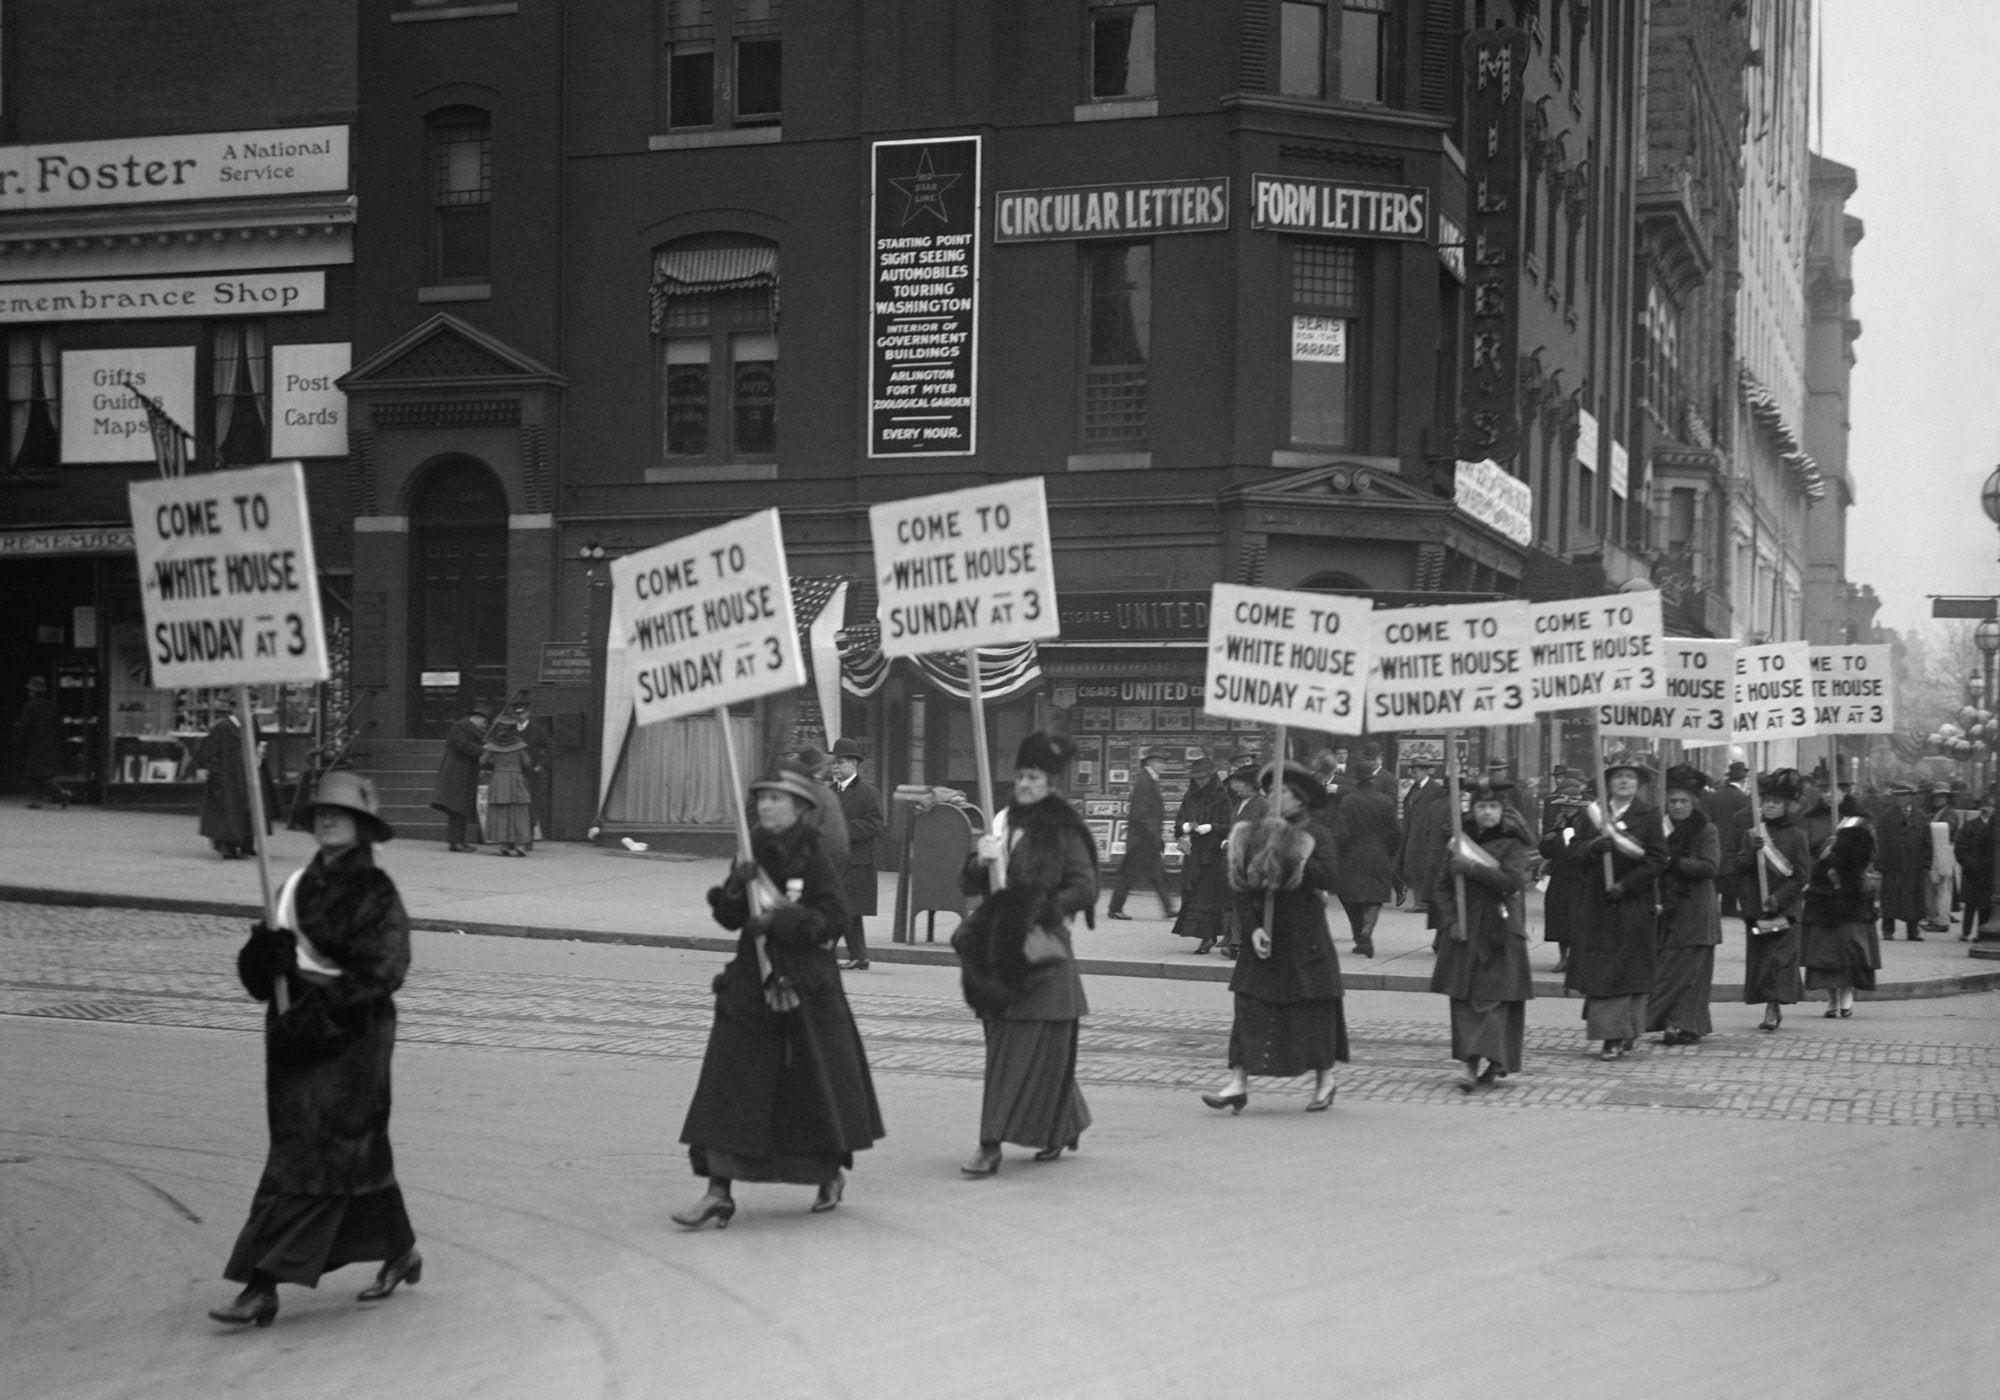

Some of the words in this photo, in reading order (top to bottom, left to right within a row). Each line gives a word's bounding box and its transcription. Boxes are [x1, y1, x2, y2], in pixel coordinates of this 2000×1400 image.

[222, 145, 237, 160] A
[243, 139, 331, 160] National
[37, 155, 197, 193] Foster
[219, 166, 295, 183] Service
[914, 183, 937, 192] STAR
[915, 194, 937, 203] LINE
[1257, 181, 1316, 226] FORM
[1322, 186, 1424, 234] LETTERS
[1000, 191, 1120, 236] CIRCULAR
[1125, 184, 1225, 230] LETTERS
[877, 236, 932, 250] STARTING
[935, 233, 973, 247] POINT
[880, 251, 917, 266] SIGHT
[919, 249, 966, 264] SEEING
[880, 265, 969, 282] AUTOMOBILES
[213, 282, 299, 308] Shop
[893, 282, 955, 298] TOURING
[875, 298, 972, 315] WASHINGTON
[886, 322, 939, 334] INTERIOR
[942, 321, 959, 331] OF
[1296, 317, 1340, 332] SEATS
[876, 332, 968, 348] GOVERNMENT
[1295, 342, 1341, 357] PARADE
[884, 346, 960, 360] BUILDINGS
[93, 369, 147, 387] Gifts
[286, 373, 330, 391] Post
[889, 369, 955, 382] ARLINGTON
[886, 384, 917, 396] FORT
[922, 383, 958, 395] MYER
[93, 393, 163, 411] Guids
[873, 398, 929, 410] ZOOLOGICAL
[284, 407, 338, 427] Cards
[92, 418, 149, 438] Maps
[882, 427, 921, 440] EVERY
[156, 500, 221, 539] COME
[233, 493, 270, 532] TO
[897, 511, 962, 544] COME
[975, 503, 1011, 532] TO
[155, 556, 221, 601] WHITE
[226, 550, 299, 596] HOUSE
[635, 558, 698, 600] COME
[711, 543, 745, 578] TO
[893, 553, 958, 590] WHITE
[964, 542, 1036, 580] HOUSE
[634, 605, 698, 651] WHITE
[703, 585, 775, 632] HOUSE
[890, 596, 980, 638] SUNDAY
[990, 603, 1014, 624] AT
[1022, 589, 1041, 621] 3
[1116, 601, 1208, 629] UNITED
[1235, 600, 1295, 630] COME
[1310, 609, 1341, 635] TO
[1535, 610, 1592, 634] COME
[1603, 606, 1633, 628] TO
[155, 617, 245, 665] SUNDAY
[255, 630, 278, 658] AT
[285, 612, 307, 657] 3
[1385, 620, 1450, 645] COME
[1464, 616, 1498, 640] TO
[1226, 635, 1286, 668] WHITE
[1290, 643, 1357, 677] HOUSE
[1530, 640, 1586, 666] WHITE
[1592, 634, 1653, 661] HOUSE
[638, 649, 723, 704] SUNDAY
[735, 654, 756, 678] AT
[763, 636, 783, 670] 3
[1381, 653, 1443, 680] WHITE
[1451, 648, 1520, 676] HOUSE
[1678, 651, 1708, 670] TO
[1758, 654, 1785, 673] TO
[1809, 656, 1833, 672] ME
[1842, 655, 1867, 671] TO
[1613, 676, 1633, 691] AT
[1639, 666, 1655, 690] 3
[1666, 677, 1725, 700] HOUSE
[1832, 678, 1883, 697] HOUSE
[1078, 685, 1118, 698] CIGARS
[1121, 681, 1188, 701] UNITED
[1213, 673, 1299, 709] SUNDAY
[1304, 695, 1327, 713] AT
[1333, 690, 1351, 717] 3
[1748, 678, 1804, 702] HOUSE
[1375, 688, 1464, 718] SUNDAY
[1473, 694, 1496, 712] AT
[1504, 684, 1524, 711] 3
[1599, 705, 1676, 728] SUNDAY
[1682, 714, 1702, 729] AT
[1707, 708, 1724, 731] 3
[1766, 714, 1784, 729] AT
[1791, 706, 1806, 727] 3
[1847, 711, 1864, 723] AT
[1870, 705, 1884, 724] 3
